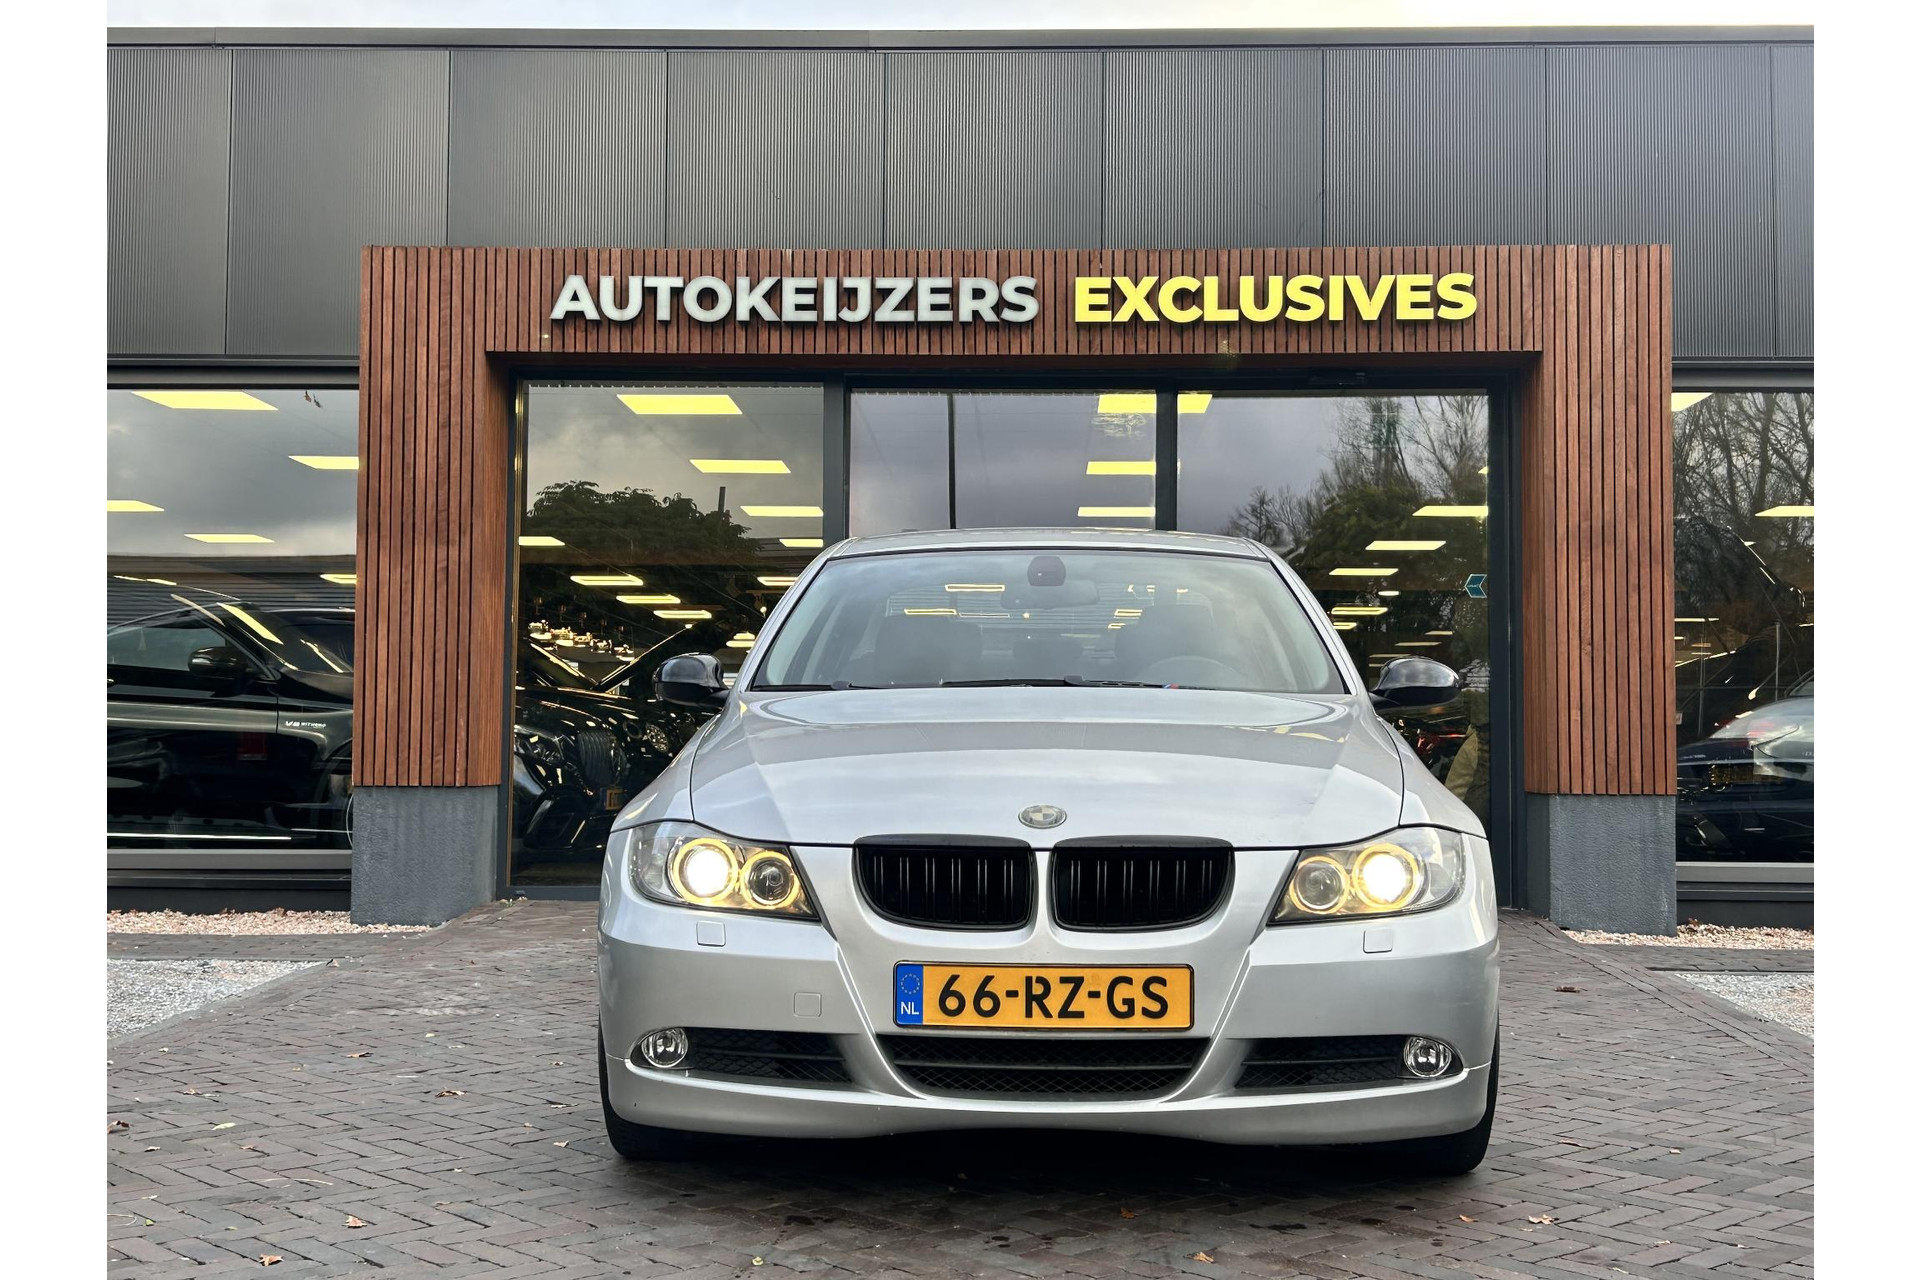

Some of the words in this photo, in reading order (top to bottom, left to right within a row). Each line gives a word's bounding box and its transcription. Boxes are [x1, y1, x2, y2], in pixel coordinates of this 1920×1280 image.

[550, 274, 1039, 323] AUTOKEIJZERS
[1074, 272, 1478, 323] EXCLUSIVES
[900, 1001, 920, 1015] NL
[938, 974, 1169, 1019] 66-RZ-GS
